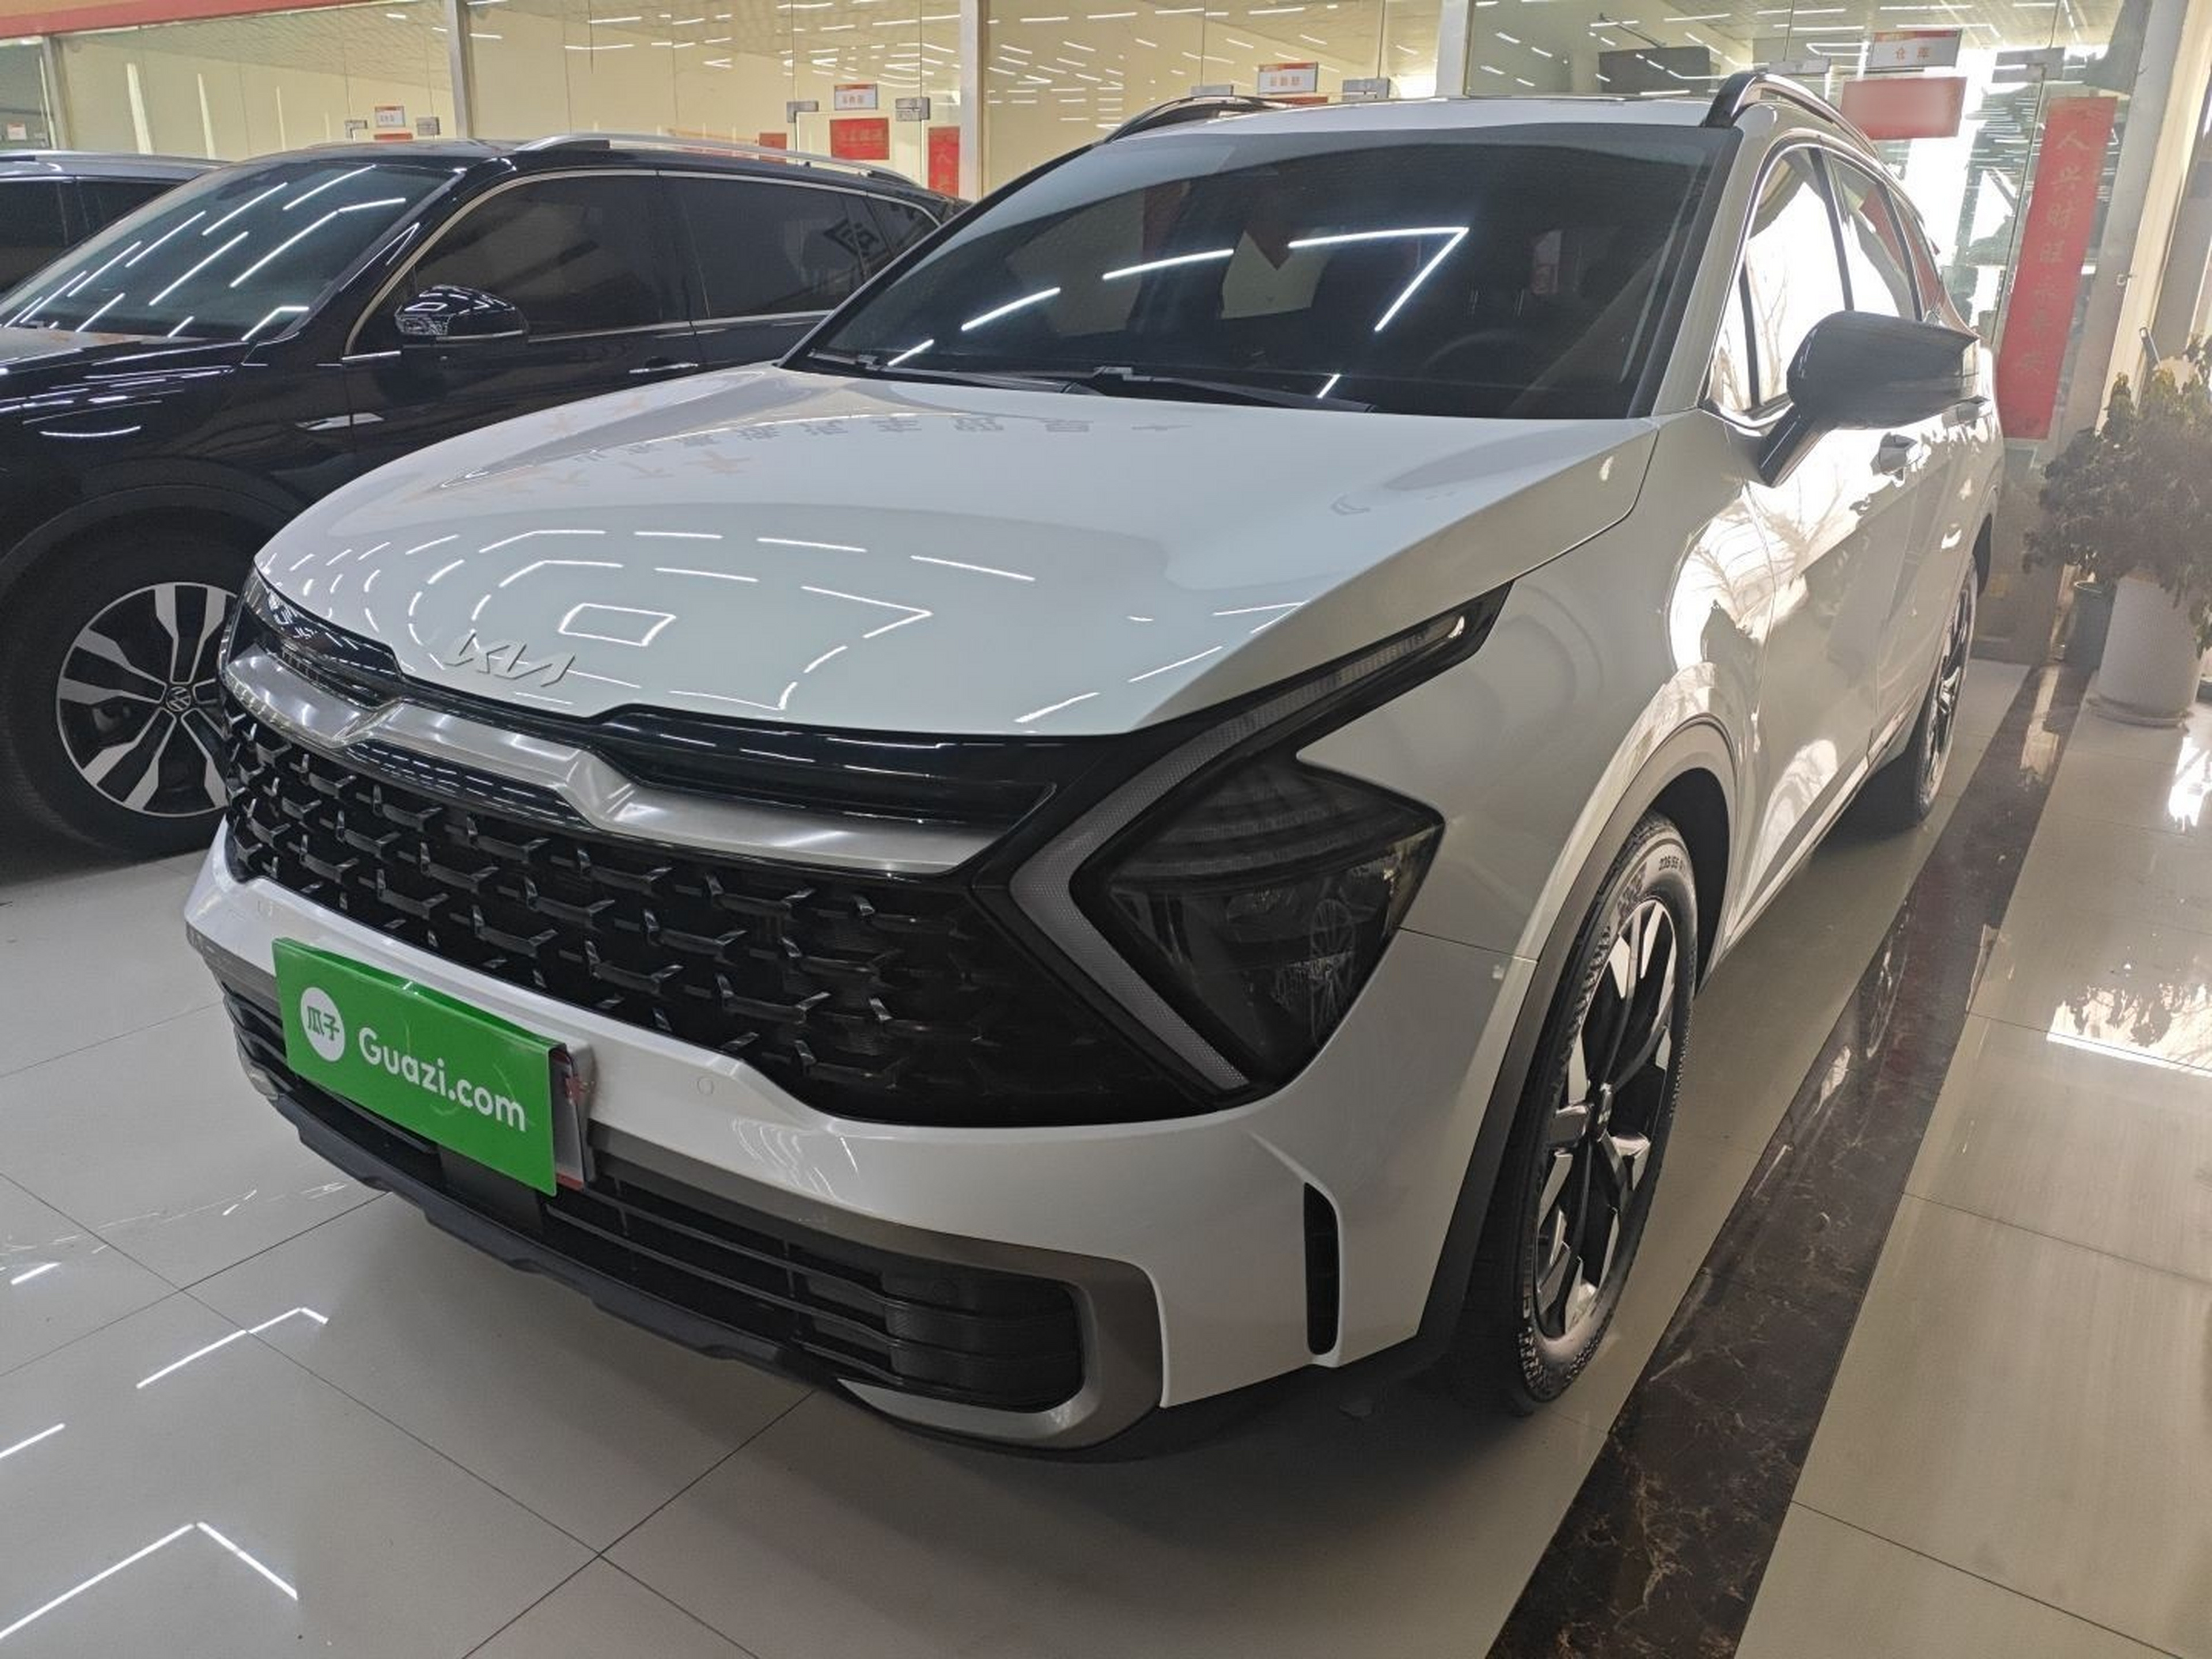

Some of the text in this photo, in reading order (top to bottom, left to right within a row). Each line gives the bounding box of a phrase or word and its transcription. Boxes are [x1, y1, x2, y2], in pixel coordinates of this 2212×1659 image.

[444, 632, 575, 687] KIA
[307, 1005, 340, 1041] 瓜子
[358, 1027, 527, 1132] Guazi.com
